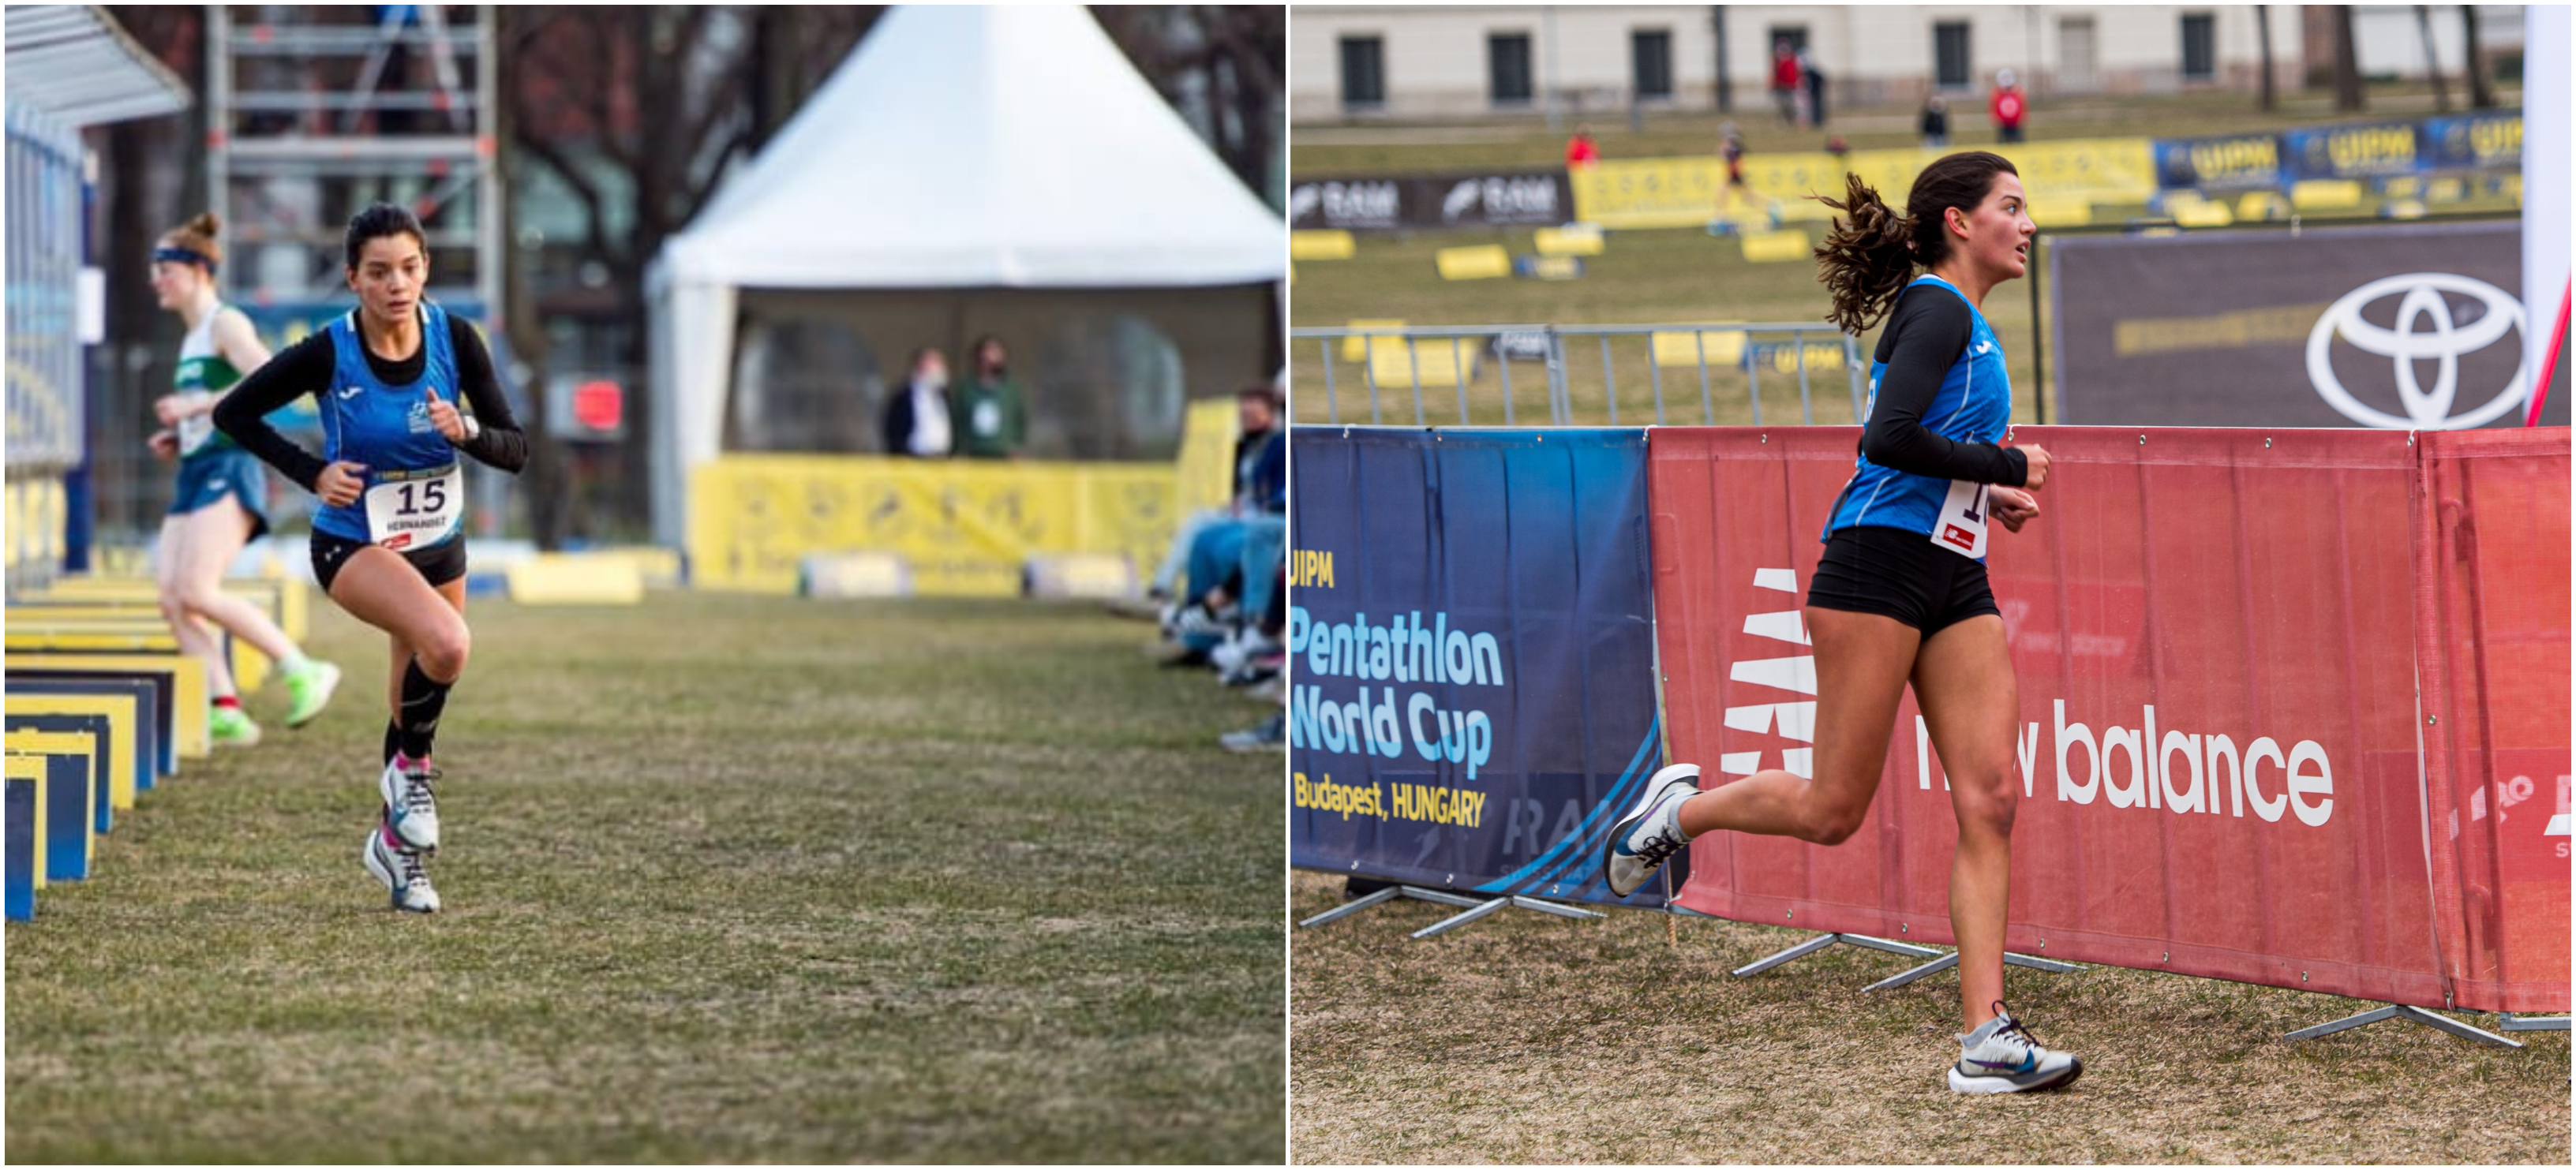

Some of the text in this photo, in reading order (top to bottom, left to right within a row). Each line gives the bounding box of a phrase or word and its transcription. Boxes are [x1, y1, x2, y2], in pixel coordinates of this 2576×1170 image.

[396, 479, 445, 515] 15
[1290, 605, 1504, 686] Pentathlon
[1290, 683, 1492, 780] World Cup
[1915, 699, 2334, 827] nw balance
[1294, 772, 1487, 828] Budapest, HUNGARY
